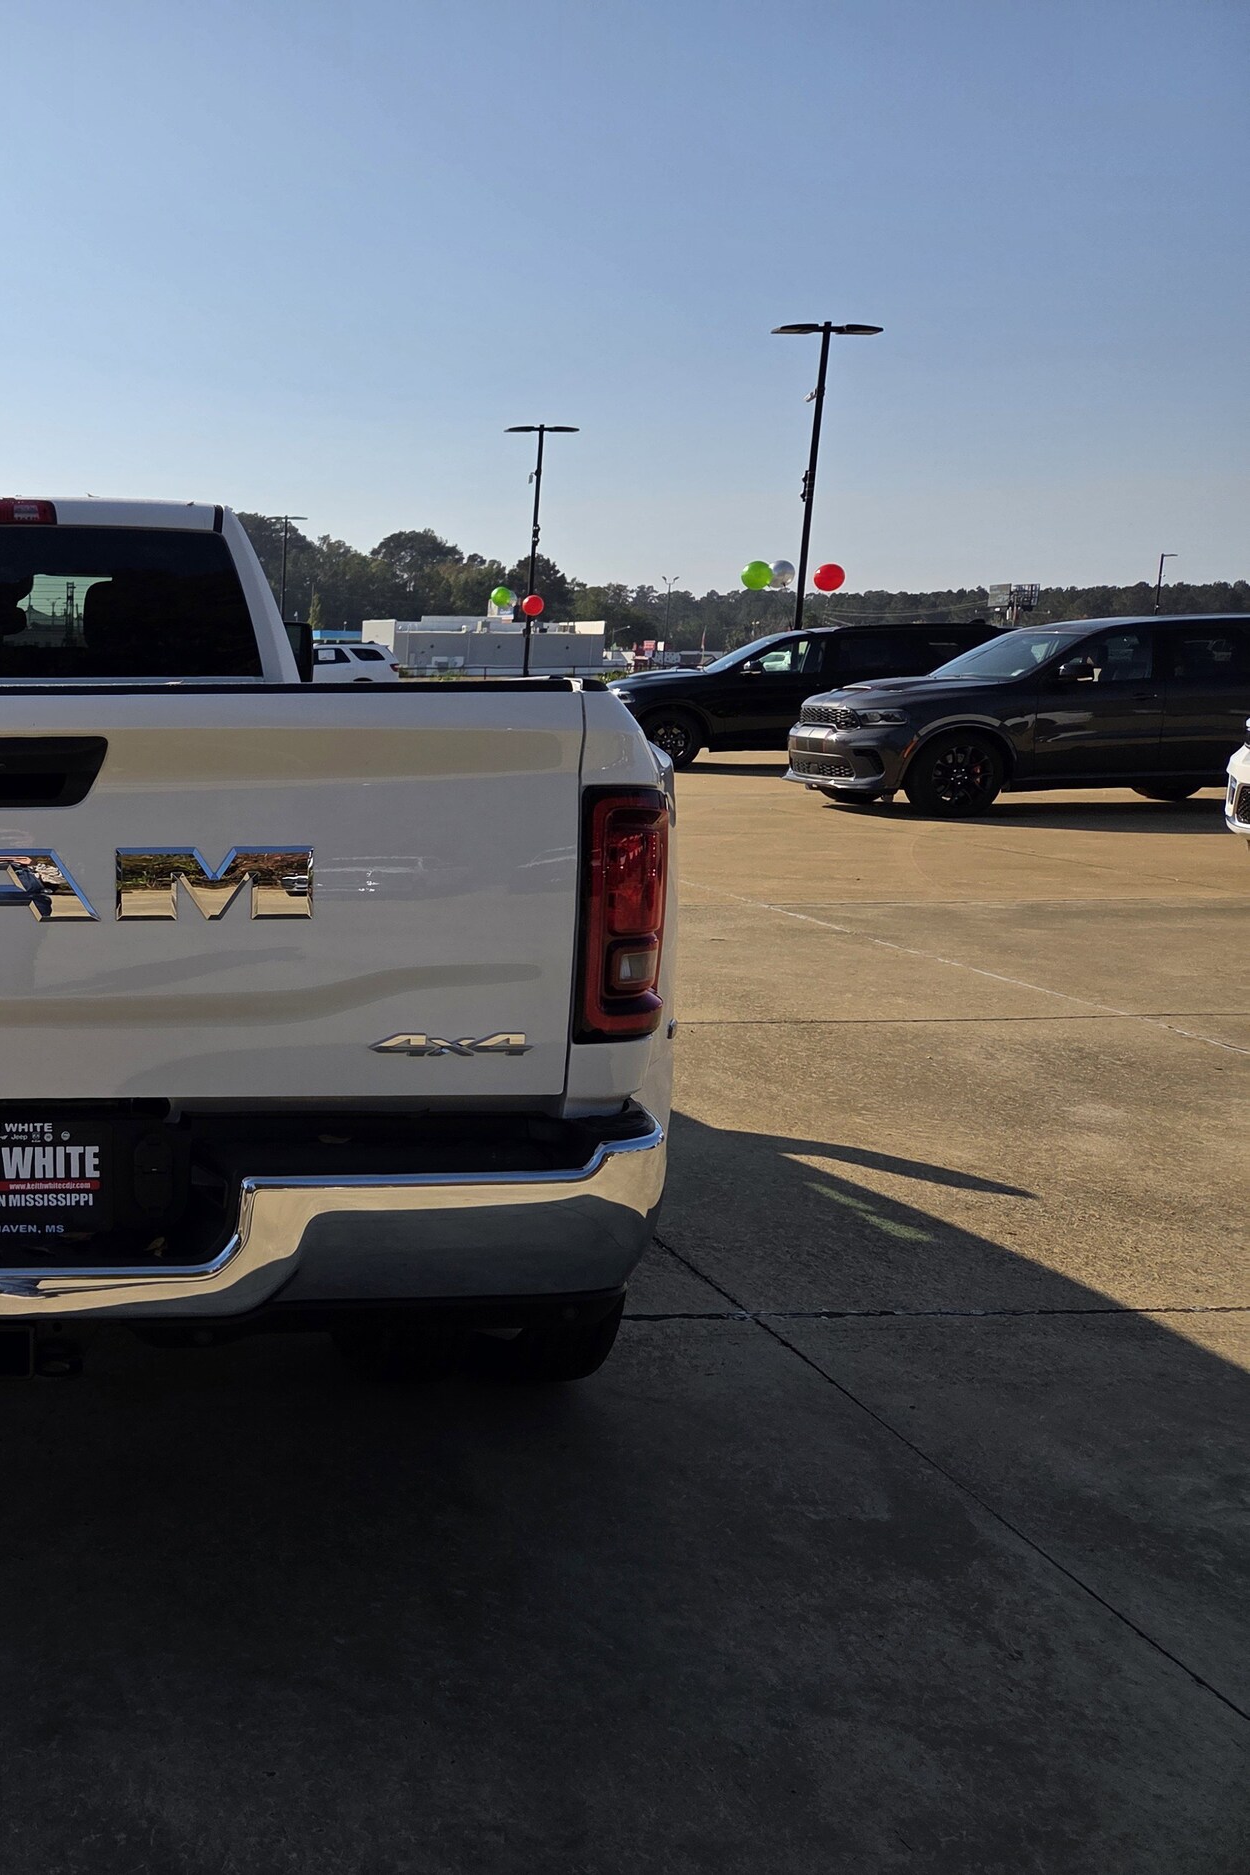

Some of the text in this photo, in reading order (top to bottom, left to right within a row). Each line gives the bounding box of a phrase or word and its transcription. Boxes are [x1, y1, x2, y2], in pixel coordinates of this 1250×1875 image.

[4, 1123, 53, 1132] WHITE
[10, 1133, 28, 1141] Jeep
[1, 1146, 100, 1179] WHITE
[9, 1182, 91, 1190] www.keithwhitecdjr.com
[8, 1194, 93, 1206] MISSISSIPPI
[45, 1225, 65, 1233] MS
